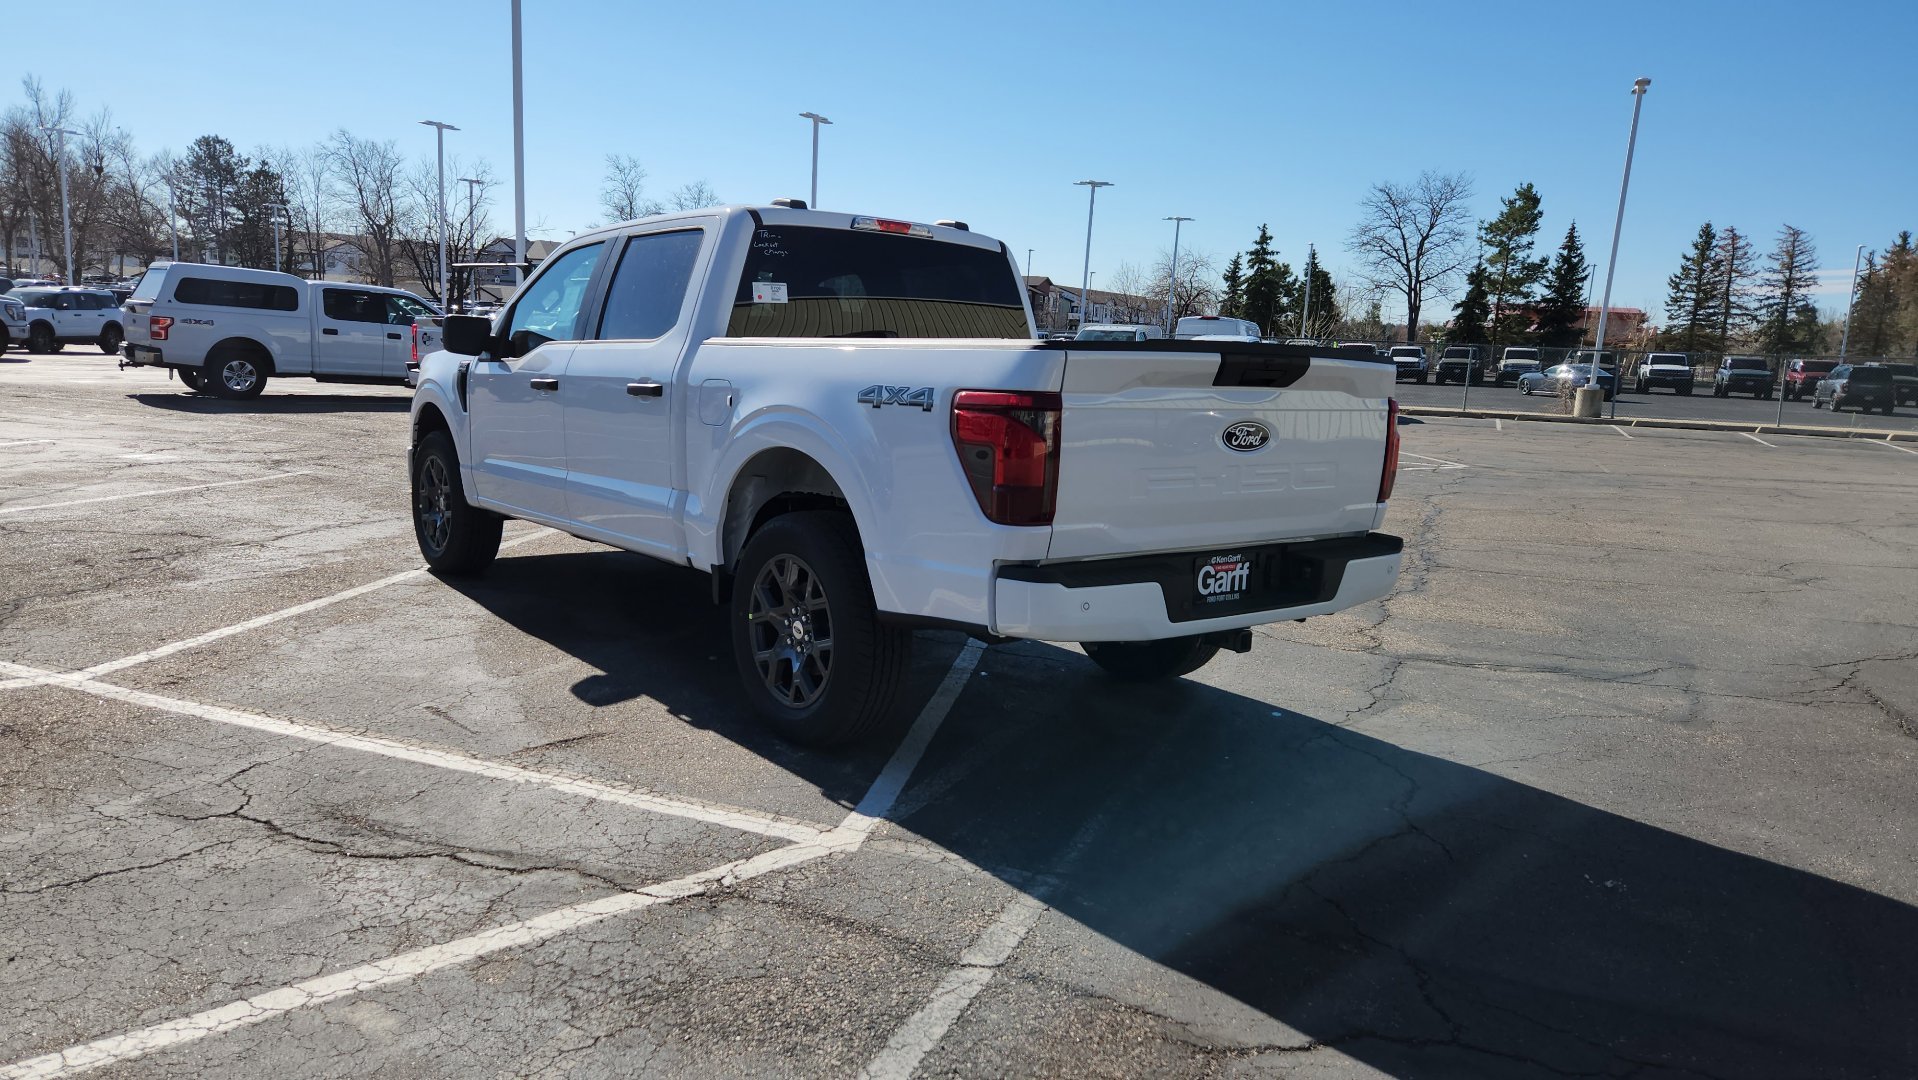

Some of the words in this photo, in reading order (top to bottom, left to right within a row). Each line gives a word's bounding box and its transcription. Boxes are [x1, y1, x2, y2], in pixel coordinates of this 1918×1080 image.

[1230, 426, 1263, 446] Ford
[1216, 555, 1228, 563] Ken
[1227, 553, 1242, 563] Garff
[1198, 561, 1250, 595] Garff
